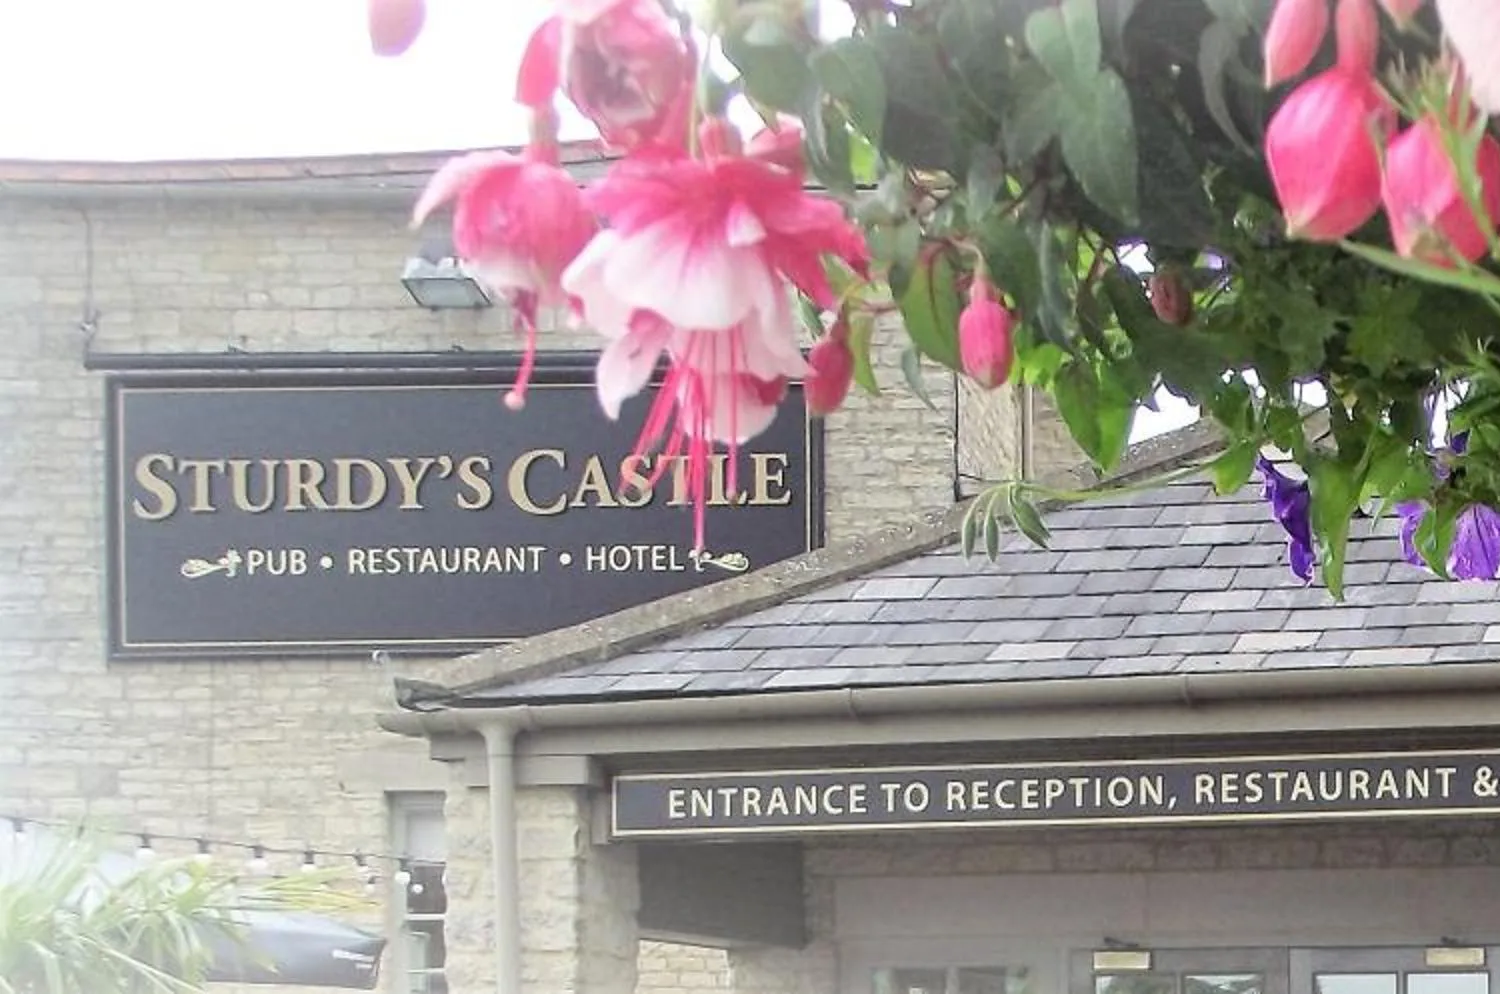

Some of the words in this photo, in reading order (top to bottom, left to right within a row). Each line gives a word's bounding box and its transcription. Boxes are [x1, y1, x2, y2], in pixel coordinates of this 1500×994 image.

[133, 452, 494, 520] STURDY’S
[247, 549, 308, 576] PUB
[349, 547, 547, 575] RESTAURANT
[585, 545, 685, 573] HOTEL
[667, 784, 868, 819] ENTRANCE
[880, 782, 930, 814] TO
[946, 774, 1178, 812] RECEPTION,
[1194, 766, 1457, 804] RESTAURANT
[1472, 765, 1500, 798] &
